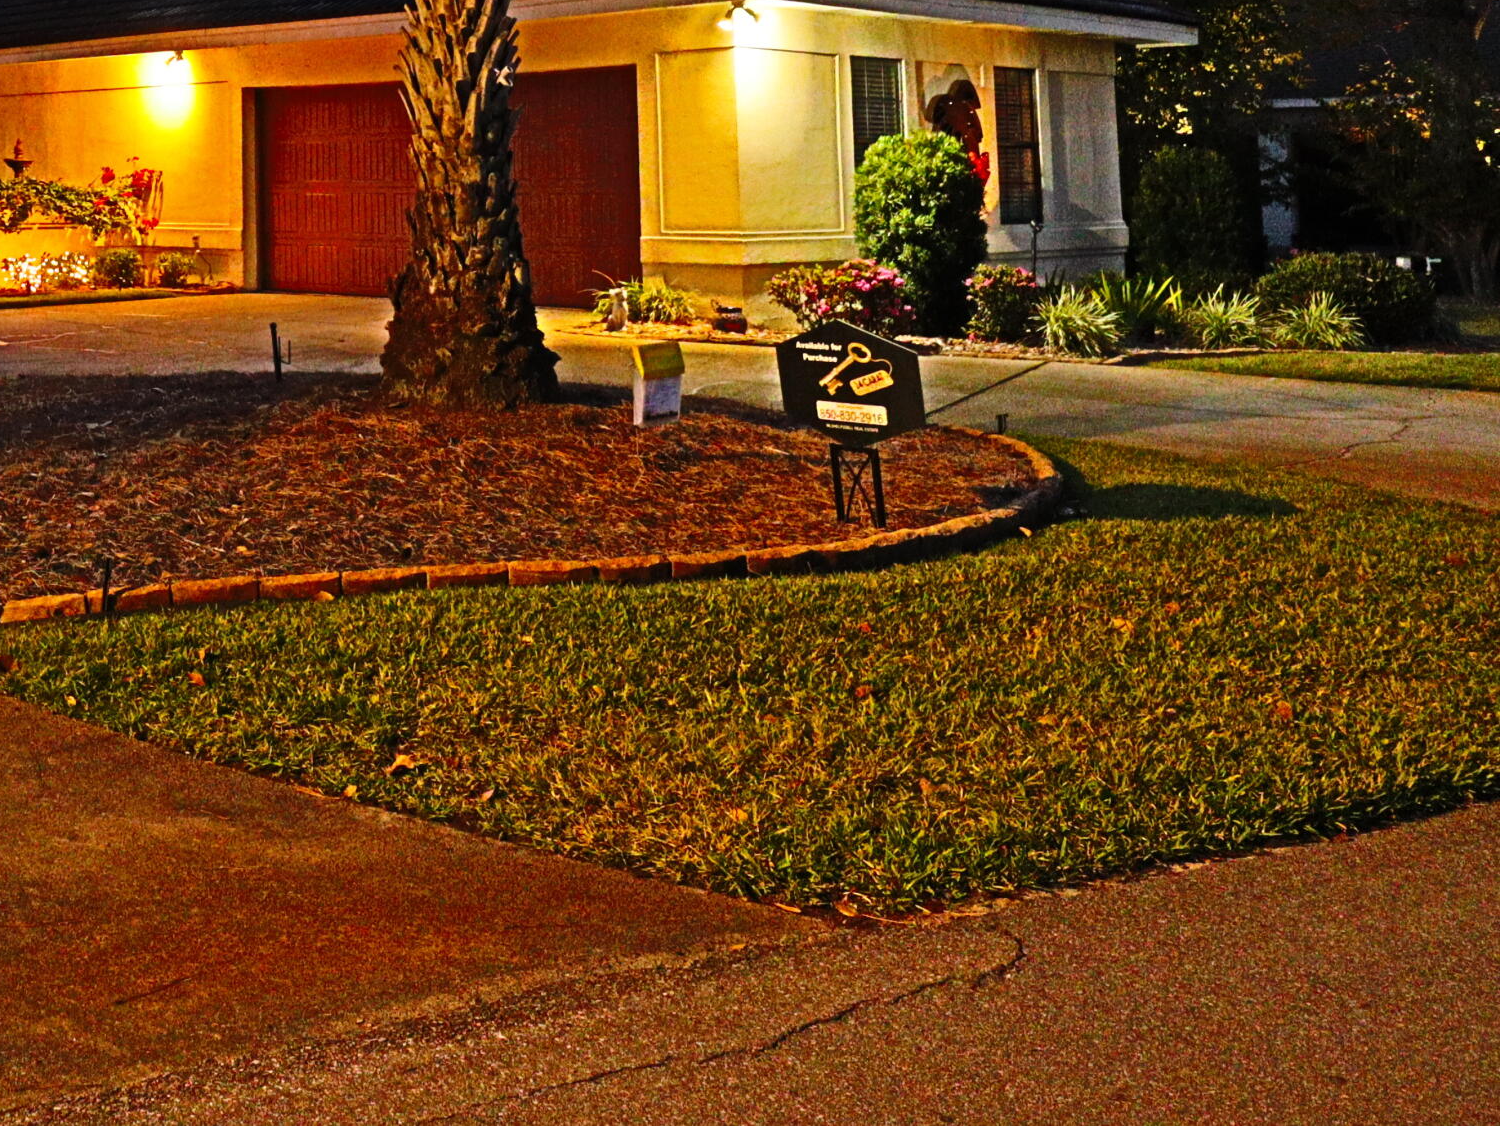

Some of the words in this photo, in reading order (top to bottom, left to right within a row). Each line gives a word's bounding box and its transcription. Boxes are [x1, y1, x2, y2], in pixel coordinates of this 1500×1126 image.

[796, 341, 829, 351] Available
[830, 342, 842, 352] for
[802, 352, 838, 363] Purchase
